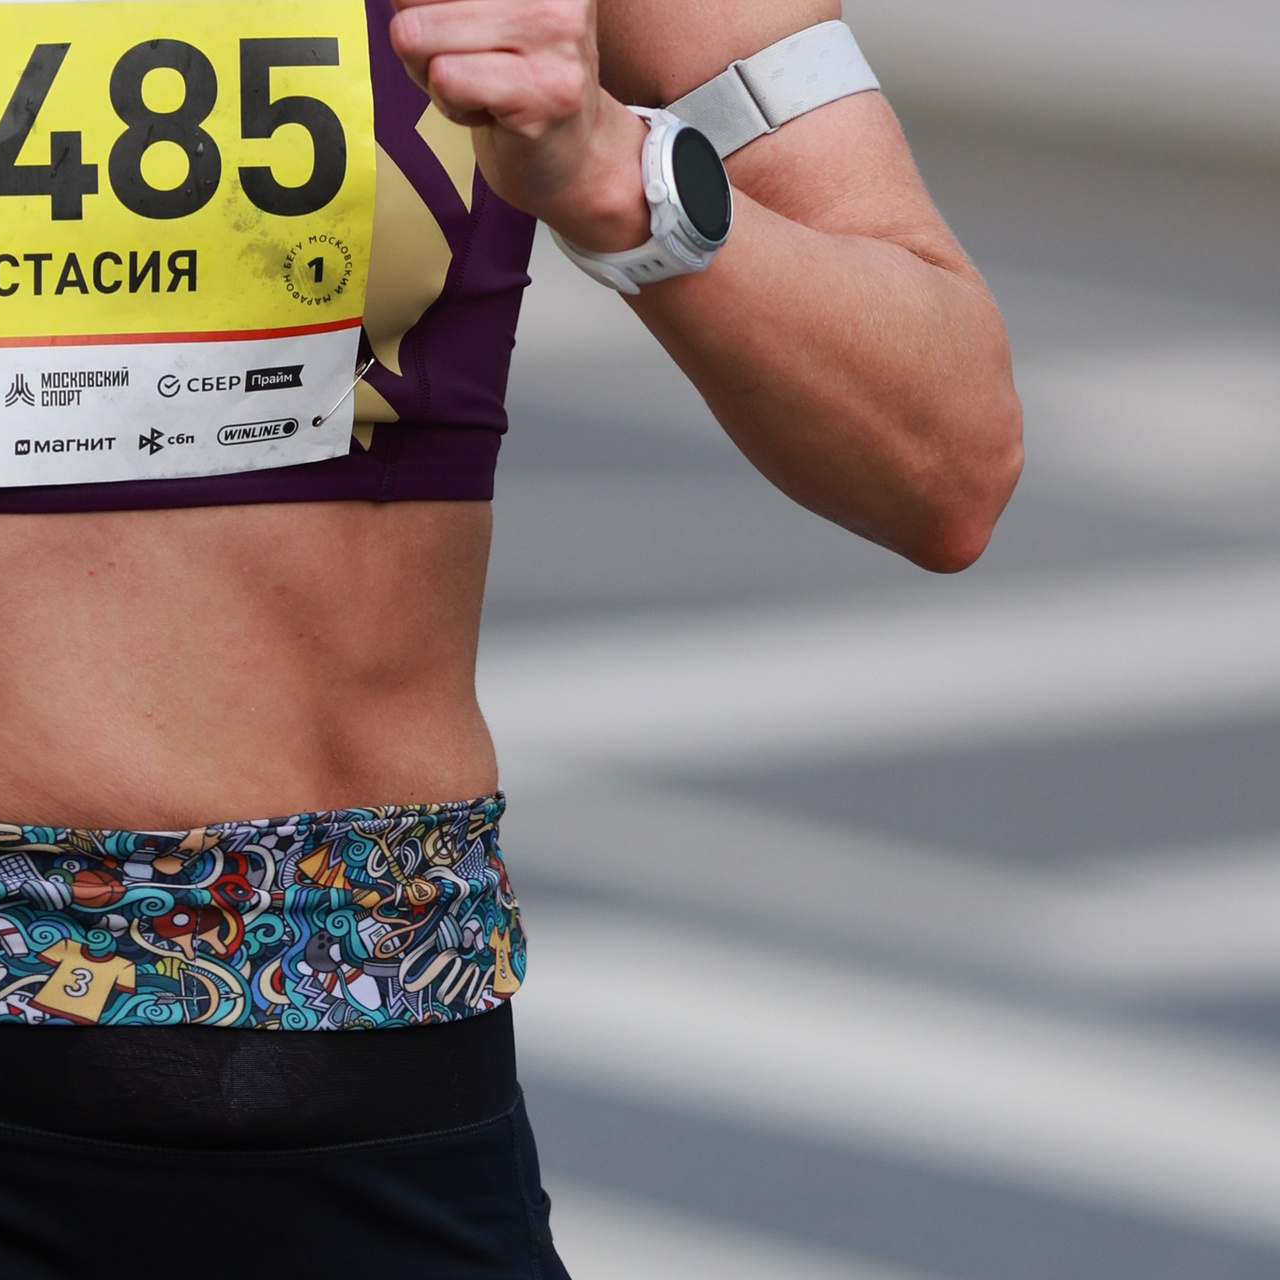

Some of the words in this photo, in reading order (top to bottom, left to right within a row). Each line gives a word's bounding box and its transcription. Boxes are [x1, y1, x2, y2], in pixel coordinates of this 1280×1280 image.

[283, 242, 302, 269] БЕГУ
[308, 234, 353, 295] МОСКОВСКИЙ
[307, 256, 324, 283] 1
[283, 274, 331, 306] МАРАФОН
[41, 366, 129, 389] МОСКОВСКИЙ
[187, 375, 241, 392] СБЕР
[251, 371, 293, 387] Прайм
[41, 390, 82, 407] СПОРТ
[224, 423, 282, 441] WINLINE
[63, 967, 93, 998] 3
